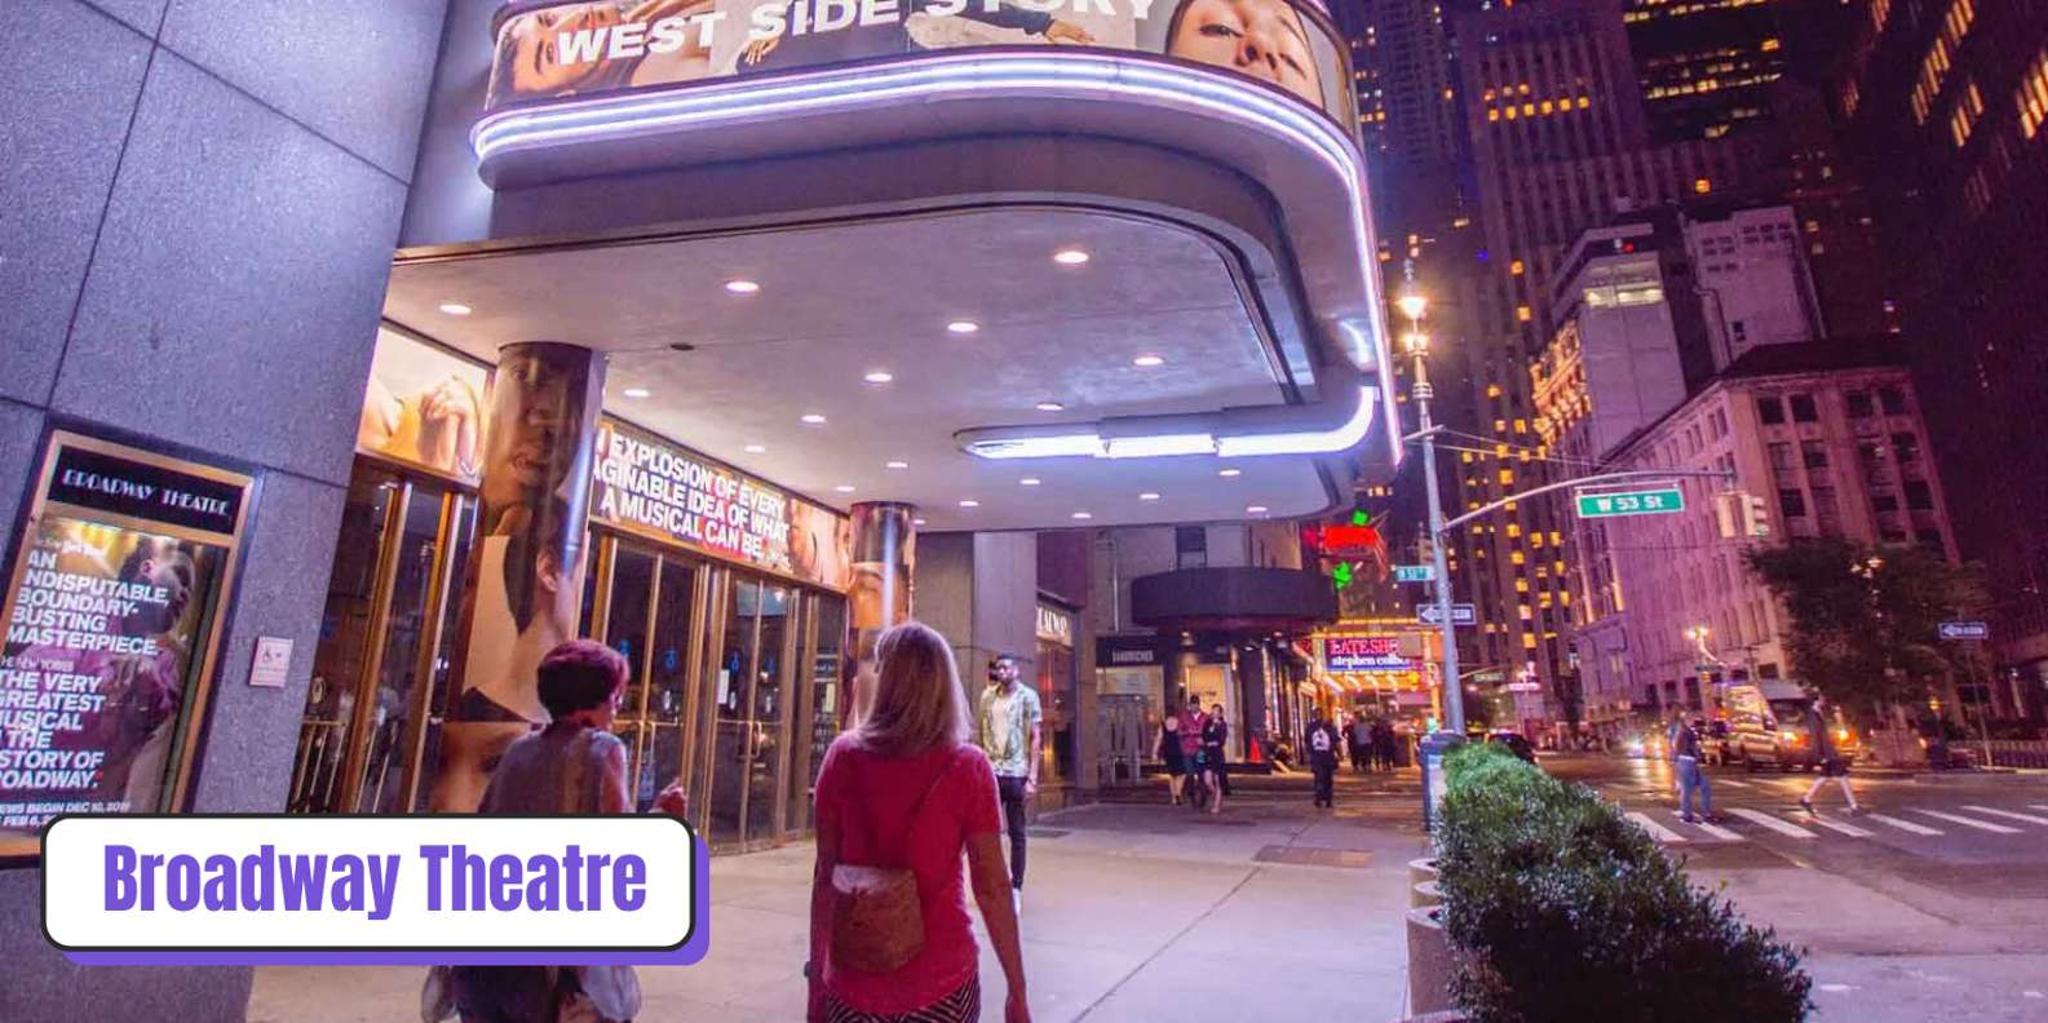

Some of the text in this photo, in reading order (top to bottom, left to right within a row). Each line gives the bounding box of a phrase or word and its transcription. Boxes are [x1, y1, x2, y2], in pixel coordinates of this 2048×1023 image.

[558, 11, 727, 65] WEST
[747, 0, 900, 40] SIDE
[608, 431, 785, 520] EXPLOSION OF EVERY
[62, 469, 230, 516] BROADWAY THEATRE
[1597, 498, 1612, 512] W
[1615, 496, 1640, 511] 53
[600, 485, 620, 520] A
[620, 491, 703, 540] MUSICAL
[704, 519, 740, 552] CAN
[688, 488, 727, 522] IDEA
[727, 503, 749, 531] OF
[750, 510, 790, 543] WHAT
[28, 550, 58, 569] AN
[16, 586, 139, 617] BOUNDARY-
[25, 570, 170, 608] NDISPUTABLE,
[11, 606, 108, 633] BUSTING
[1332, 653, 1375, 669] stephen
[0, 669, 103, 693] THE VERY
[0, 710, 83, 731] USICAL
[7, 730, 53, 749] THE
[74, 752, 105, 769] OF
[26, 802, 64, 814] BEGIN
[65, 802, 90, 813] DEC
